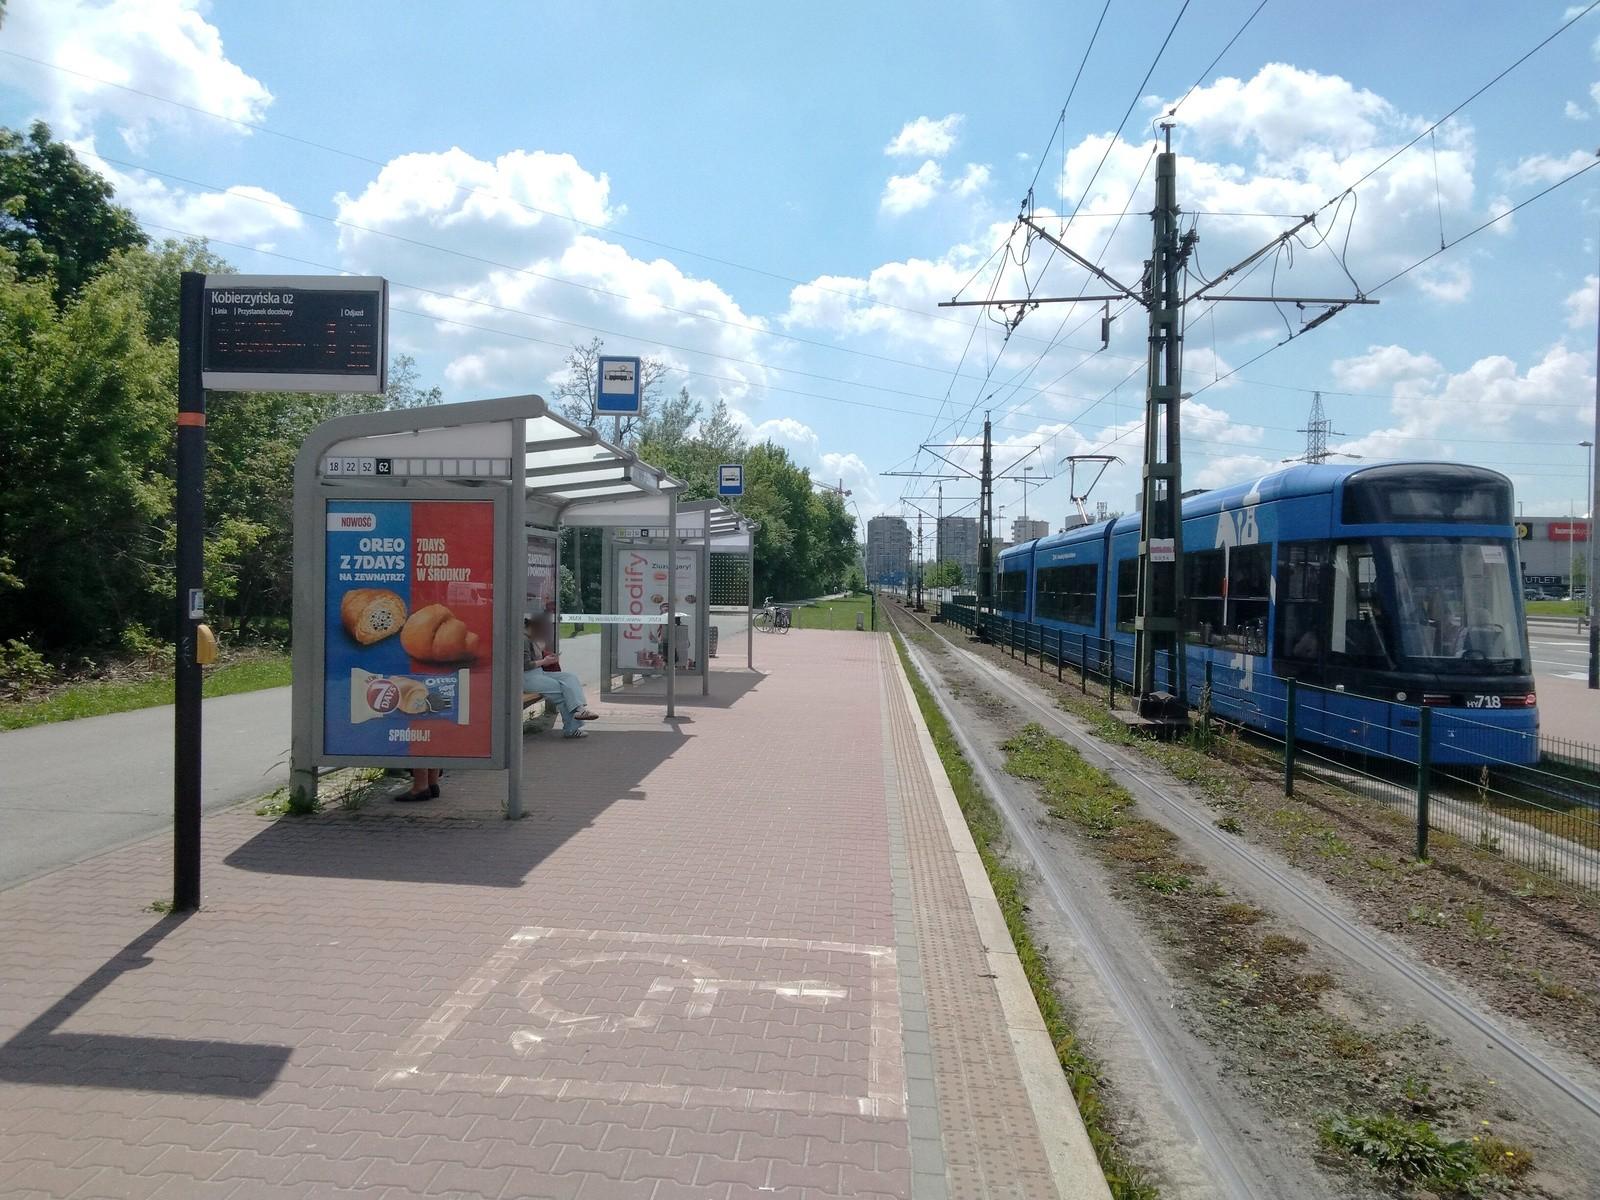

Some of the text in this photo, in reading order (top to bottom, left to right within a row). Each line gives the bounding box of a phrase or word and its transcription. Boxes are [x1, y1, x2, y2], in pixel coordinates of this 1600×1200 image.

[211, 291, 294, 306] Kobierzyńska 02
[237, 307, 266, 317] Przystanek
[329, 461, 389, 472] 18 22 52 62
[341, 514, 372, 528] NOWOŚĆ
[359, 537, 405, 553] OREO
[416, 538, 445, 551] 7DAYS
[340, 554, 405, 570] Z 7DAYS
[416, 553, 449, 567] Z OREO
[339, 572, 405, 584] NA ZEWNĄTRZ?
[416, 565, 471, 582] W ŚRODKU?
[1525, 576, 1557, 584] UTLET
[624, 552, 648, 641] foodify
[381, 686, 397, 709] DAYS
[388, 728, 431, 742] SPRÓBUJ!
